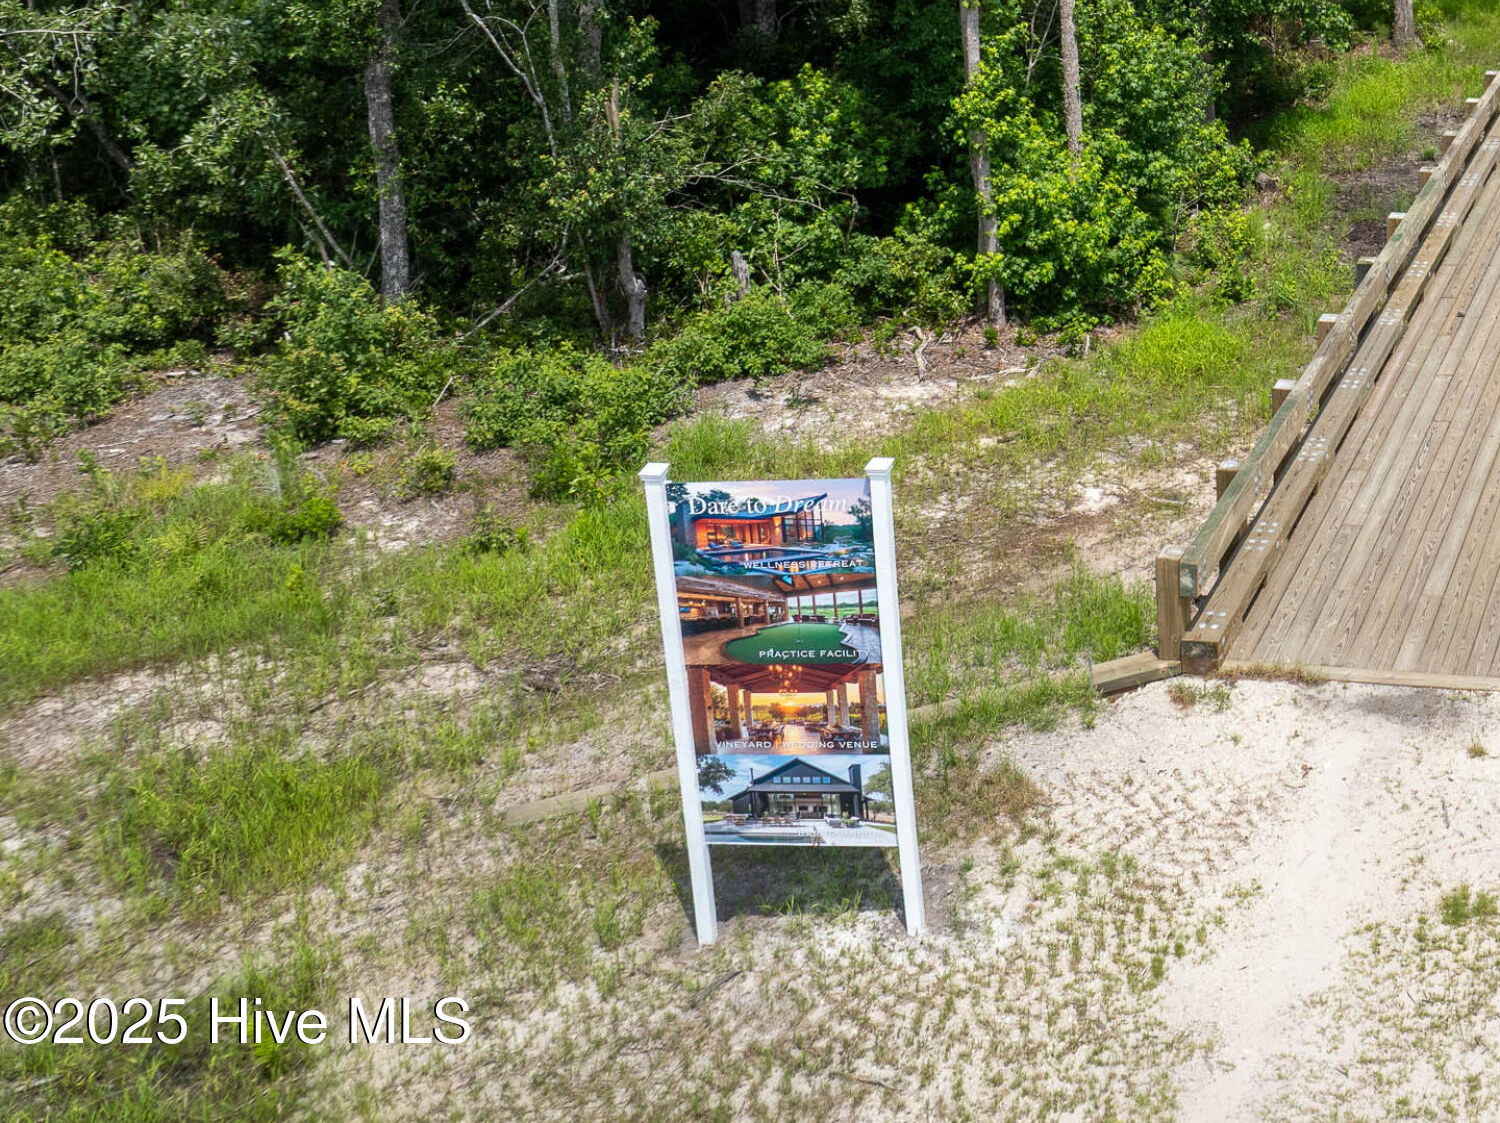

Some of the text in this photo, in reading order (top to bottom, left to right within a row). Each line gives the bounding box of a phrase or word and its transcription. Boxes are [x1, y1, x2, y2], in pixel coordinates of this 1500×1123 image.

[689, 497, 737, 516] Dare
[747, 498, 767, 515] to
[744, 559, 864, 569] WELLNESS RETREAT
[759, 649, 868, 658] PRACTICE FACILITY
[717, 741, 772, 749] VINEYARD
[782, 741, 835, 749] WEDDING
[838, 740, 878, 749] VENUE
